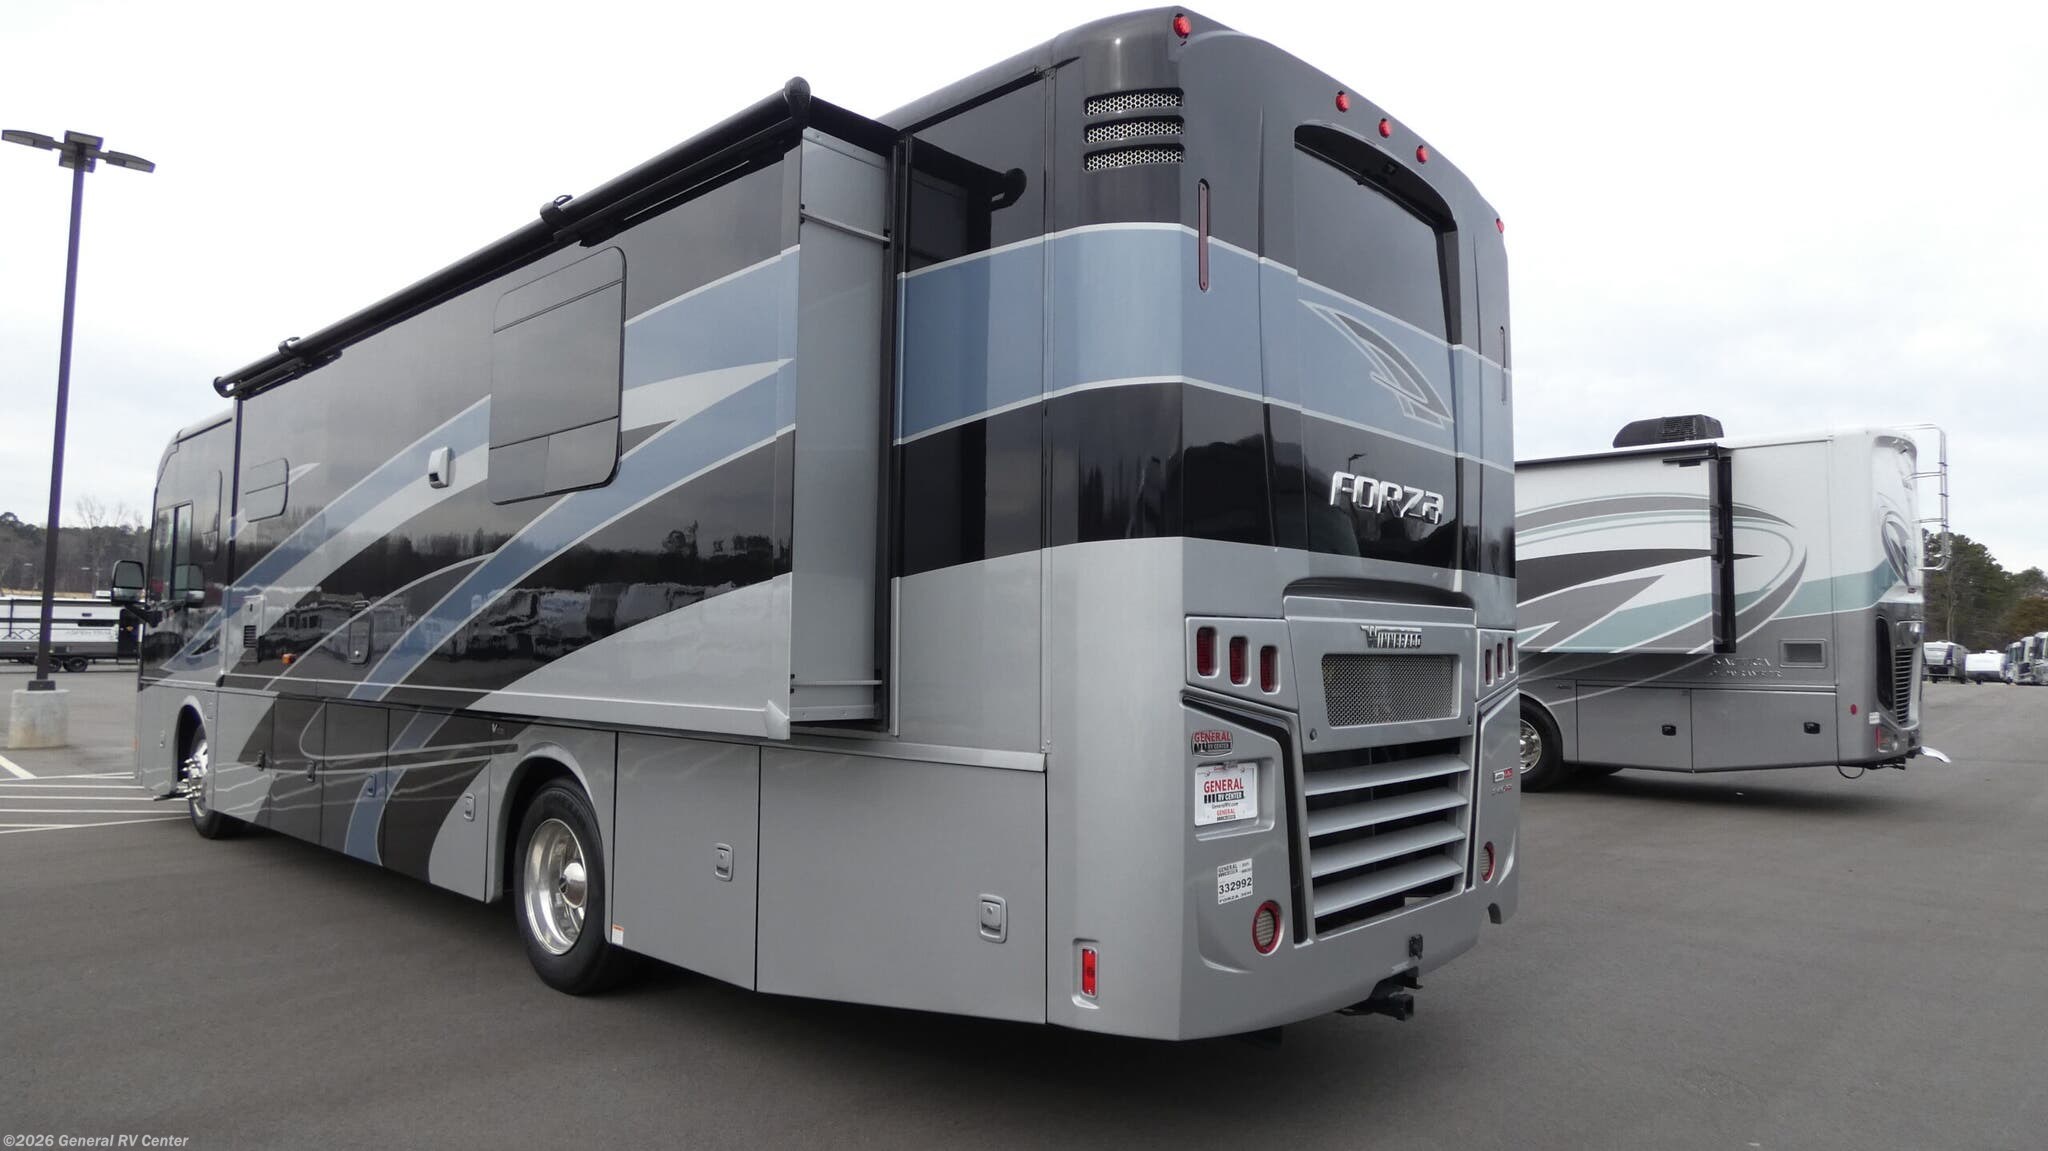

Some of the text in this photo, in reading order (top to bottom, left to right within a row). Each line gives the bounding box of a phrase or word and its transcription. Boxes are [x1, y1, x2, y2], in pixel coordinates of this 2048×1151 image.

[1330, 471, 1444, 525] FORZA
[1194, 731, 1231, 743] GENERAL
[1204, 778, 1244, 793] GENERAL
[1225, 791, 1243, 800] CENTER
[1219, 877, 1252, 894] 332992
